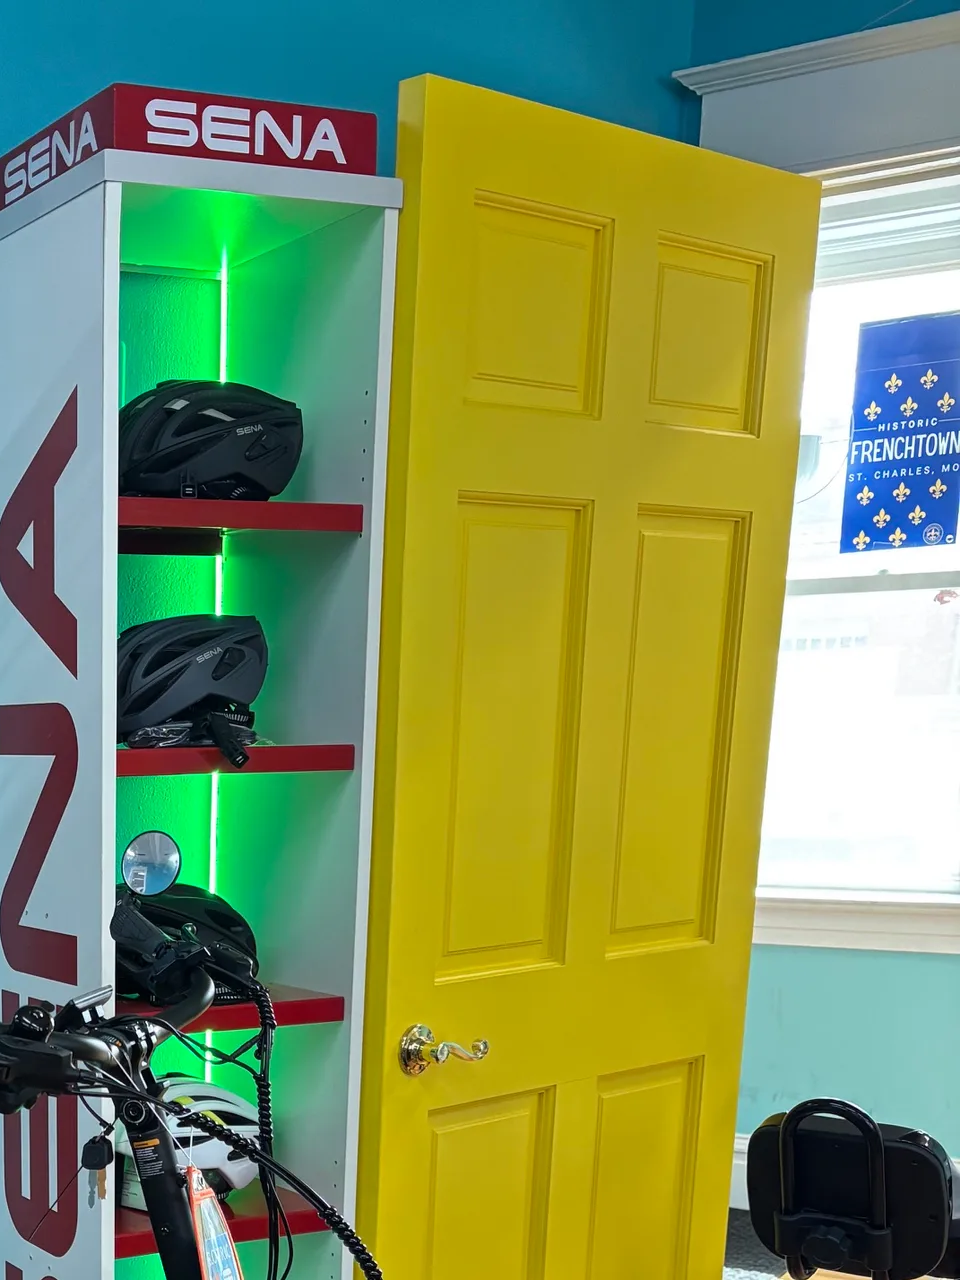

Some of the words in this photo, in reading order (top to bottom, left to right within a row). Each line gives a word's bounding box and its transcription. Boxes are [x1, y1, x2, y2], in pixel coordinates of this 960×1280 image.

[145, 98, 347, 165] SENA
[3, 111, 99, 206] SENA
[236, 423, 264, 437] SENA
[878, 417, 938, 432] HISTORIC
[850, 431, 960, 465] FRENCHTOWN
[848, 473, 867, 482] ST.
[874, 466, 935, 480] CHARLES,
[941, 463, 960, 473] MO
[195, 646, 223, 665] SENA
